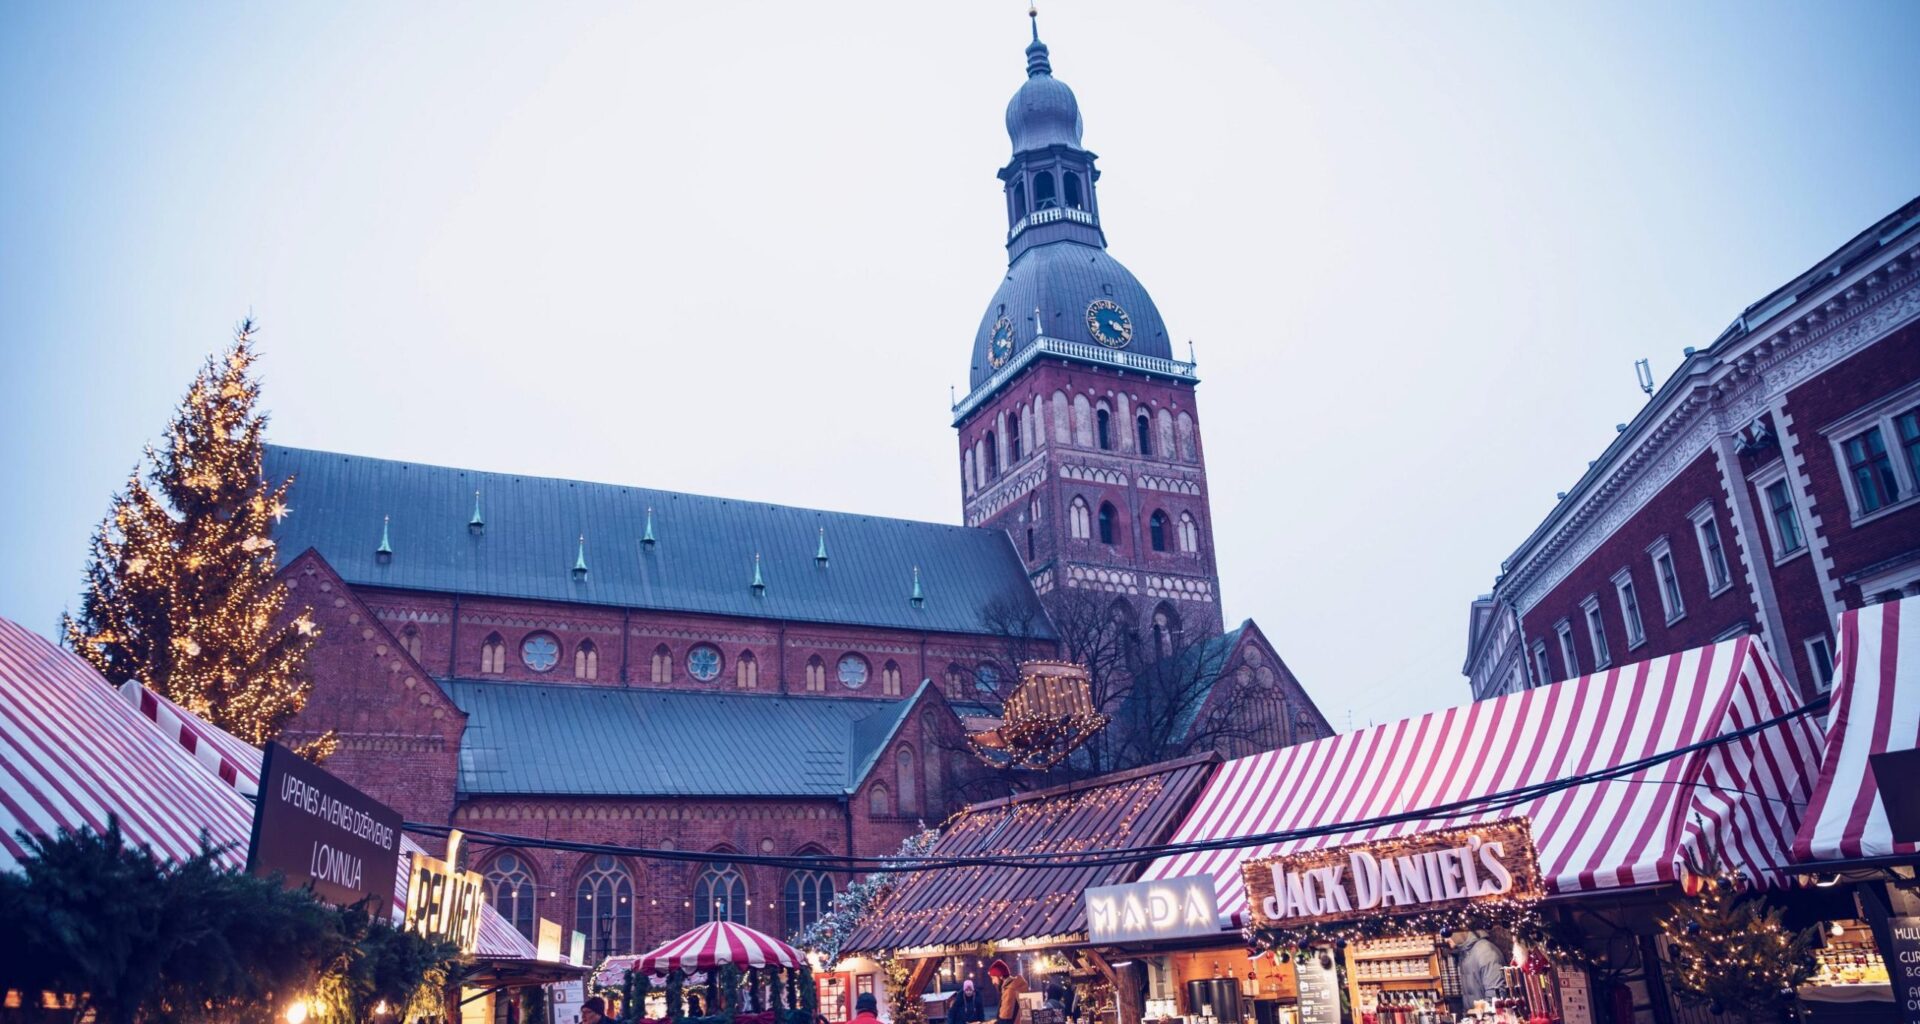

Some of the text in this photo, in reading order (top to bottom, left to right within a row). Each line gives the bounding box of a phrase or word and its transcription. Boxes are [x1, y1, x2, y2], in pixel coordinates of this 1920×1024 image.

[281, 772, 320, 815] UPENES
[318, 793, 354, 832] AVENES
[310, 840, 362, 891] LONNIJA
[1263, 834, 1513, 920] JACK DANIEL'S
